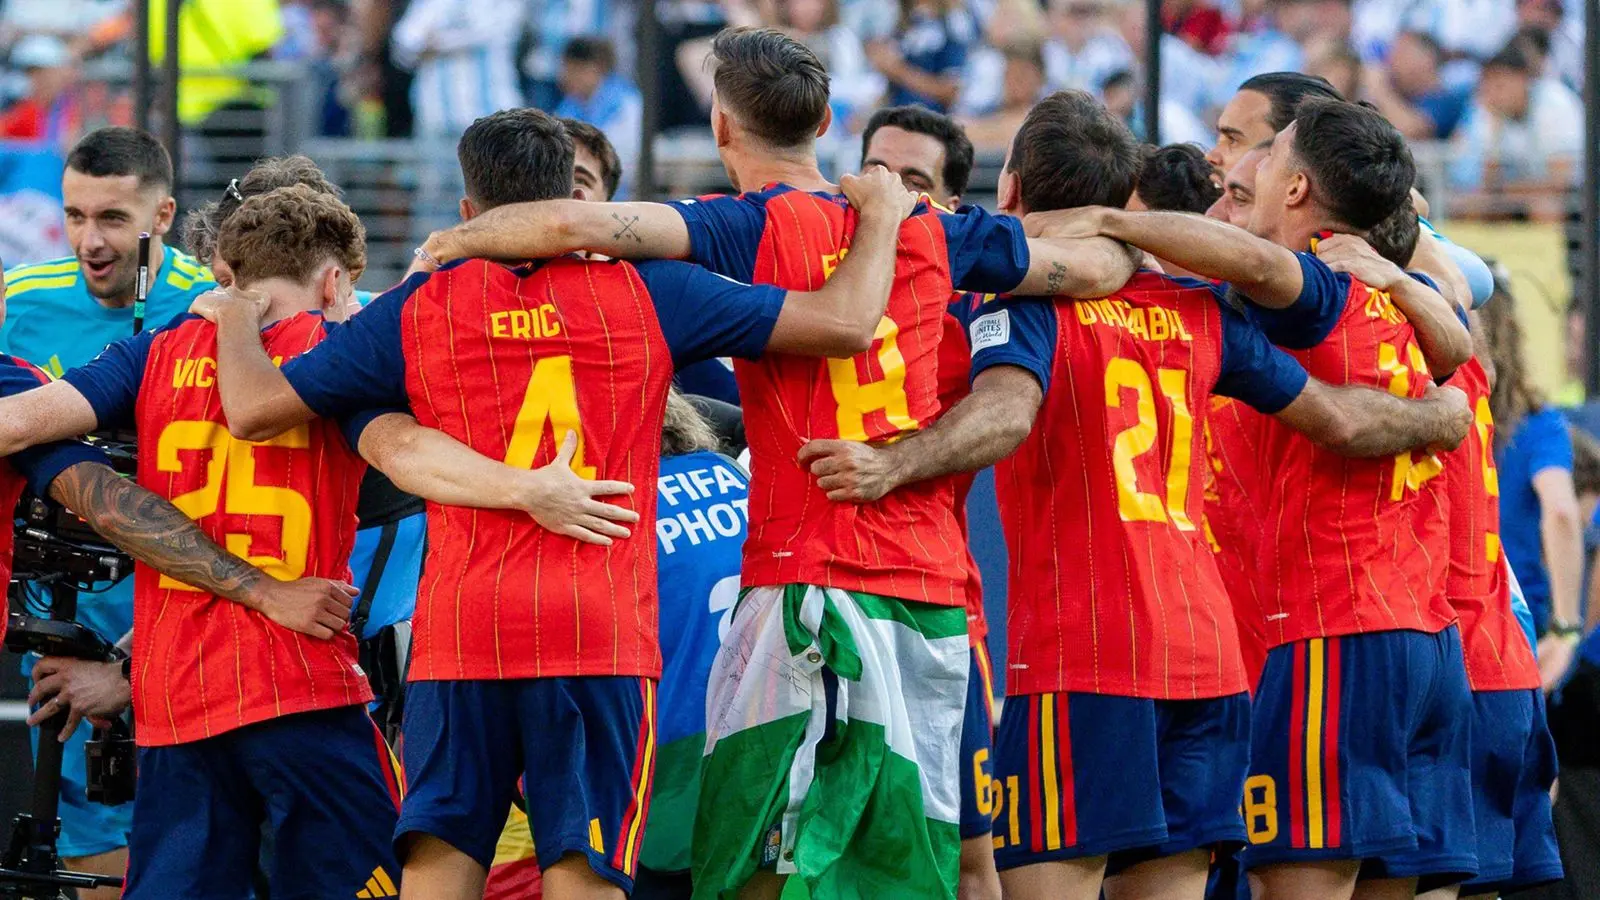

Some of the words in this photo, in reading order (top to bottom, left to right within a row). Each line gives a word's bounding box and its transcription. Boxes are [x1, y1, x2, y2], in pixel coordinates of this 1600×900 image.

[490, 303, 560, 339] ERIC
[503, 355, 597, 482] 4
[1104, 356, 1196, 531] 21
[157, 420, 312, 592] 25
[657, 465, 746, 506] FIFA
[991, 775, 1020, 849] 21
